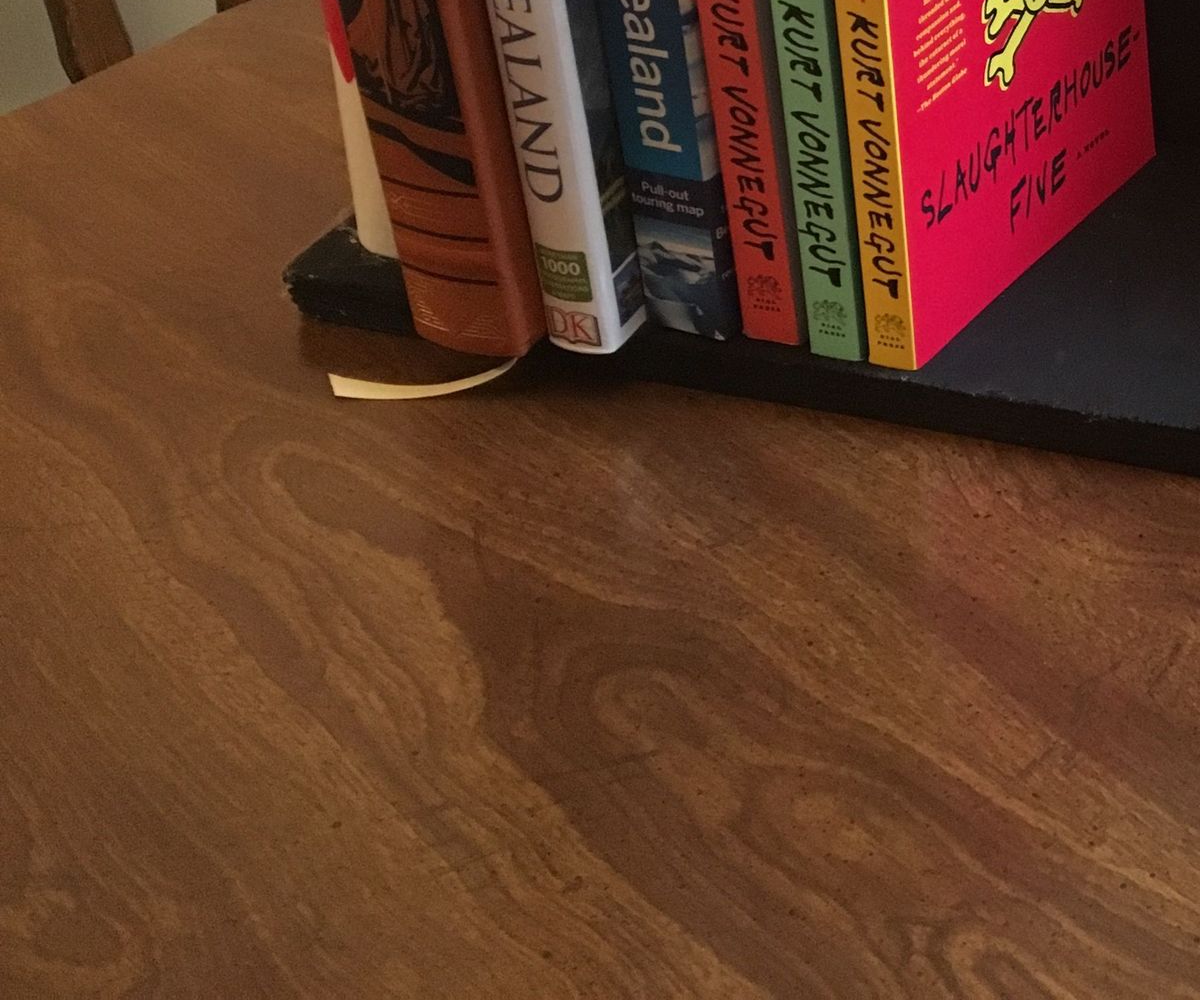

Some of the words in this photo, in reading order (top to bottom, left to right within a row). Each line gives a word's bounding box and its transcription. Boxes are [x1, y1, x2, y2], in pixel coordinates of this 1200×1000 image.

[777, 0, 822, 103] KURT
[847, 11, 884, 112] KURT
[721, 86, 777, 261] VONNEGUT
[921, 25, 1140, 229] SLAUGHTERHOUSE-
[632, 193, 675, 213] touring
[676, 203, 704, 218] map
[641, 181, 689, 201] Pull-out
[790, 110, 846, 288] VONNEGUT
[858, 119, 902, 300] VONNEGUT
[1010, 148, 1068, 234] FIVE
[541, 256, 580, 276] 1000
[548, 308, 593, 341] DK
